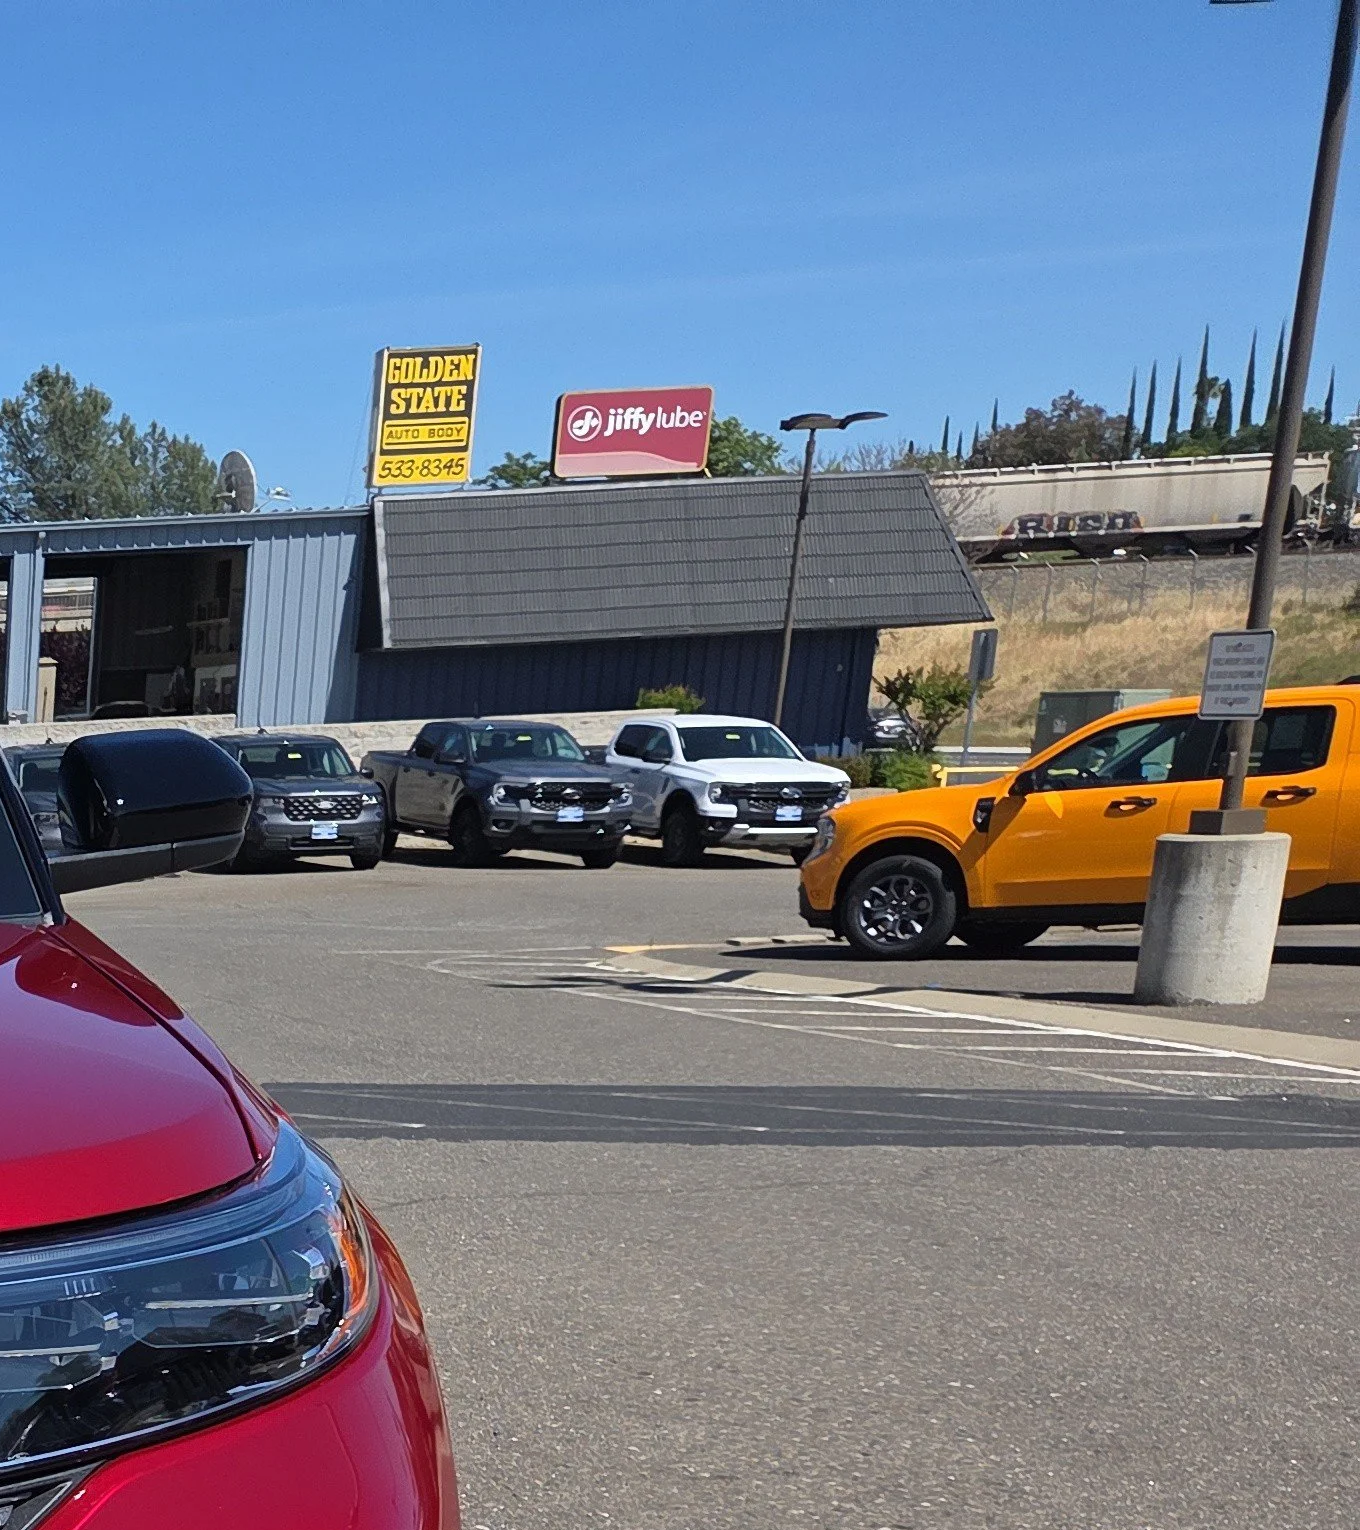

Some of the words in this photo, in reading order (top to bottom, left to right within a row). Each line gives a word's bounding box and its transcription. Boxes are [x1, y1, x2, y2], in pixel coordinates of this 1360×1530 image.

[388, 354, 475, 384] GOLDEN
[390, 385, 467, 415] STATE
[386, 428, 420, 440] AUTO
[428, 426, 464, 438] BODY
